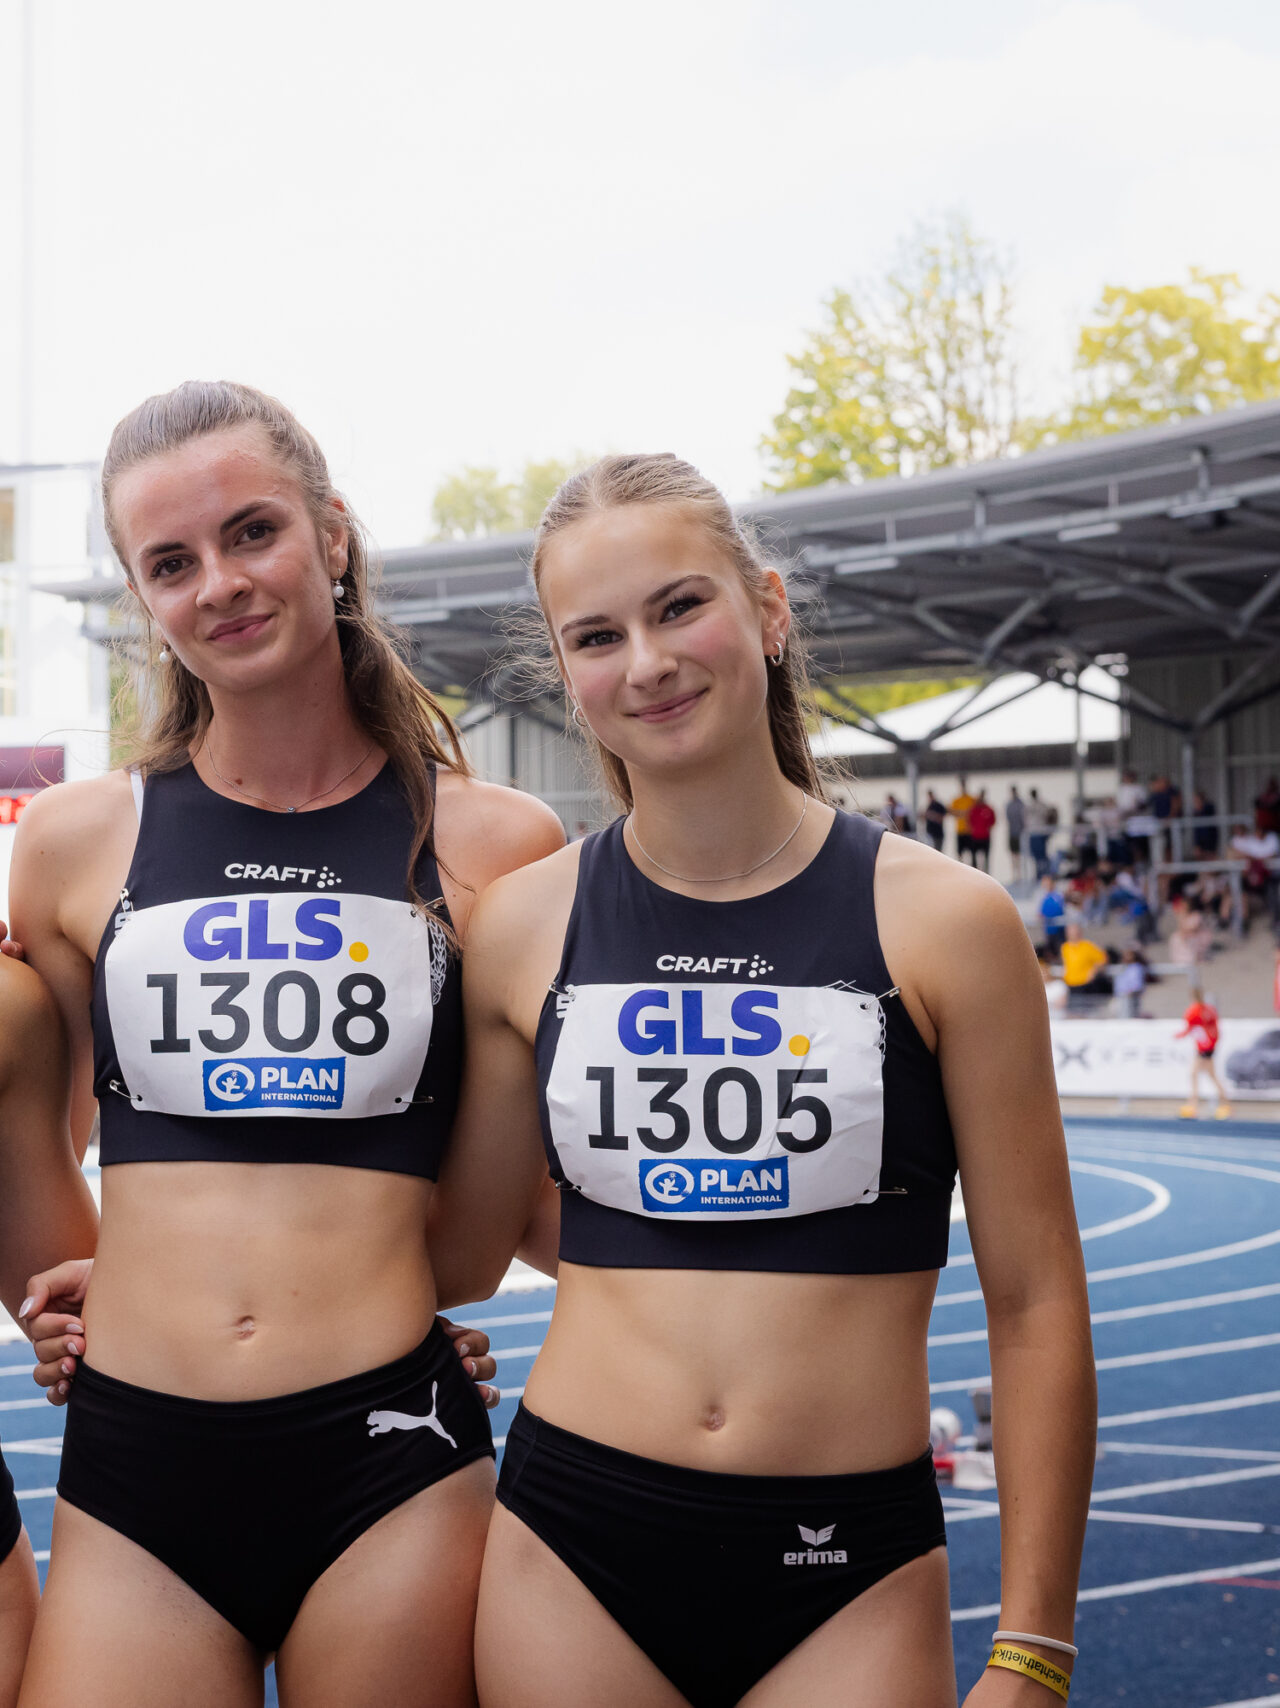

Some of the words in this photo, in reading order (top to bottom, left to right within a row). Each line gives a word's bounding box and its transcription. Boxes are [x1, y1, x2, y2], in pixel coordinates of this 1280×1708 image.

[224, 862, 316, 884] CRAFT
[656, 954, 748, 975] CRAFT
[146, 970, 390, 1057] 1308
[260, 1066, 340, 1092] PLAN
[260, 1092, 338, 1103] INTERNATIONAL
[585, 1066, 833, 1155] 1305
[700, 1168, 783, 1193] PLAN
[700, 1194, 783, 1205] INTERNATIONAL
[783, 1548, 848, 1566] erima
